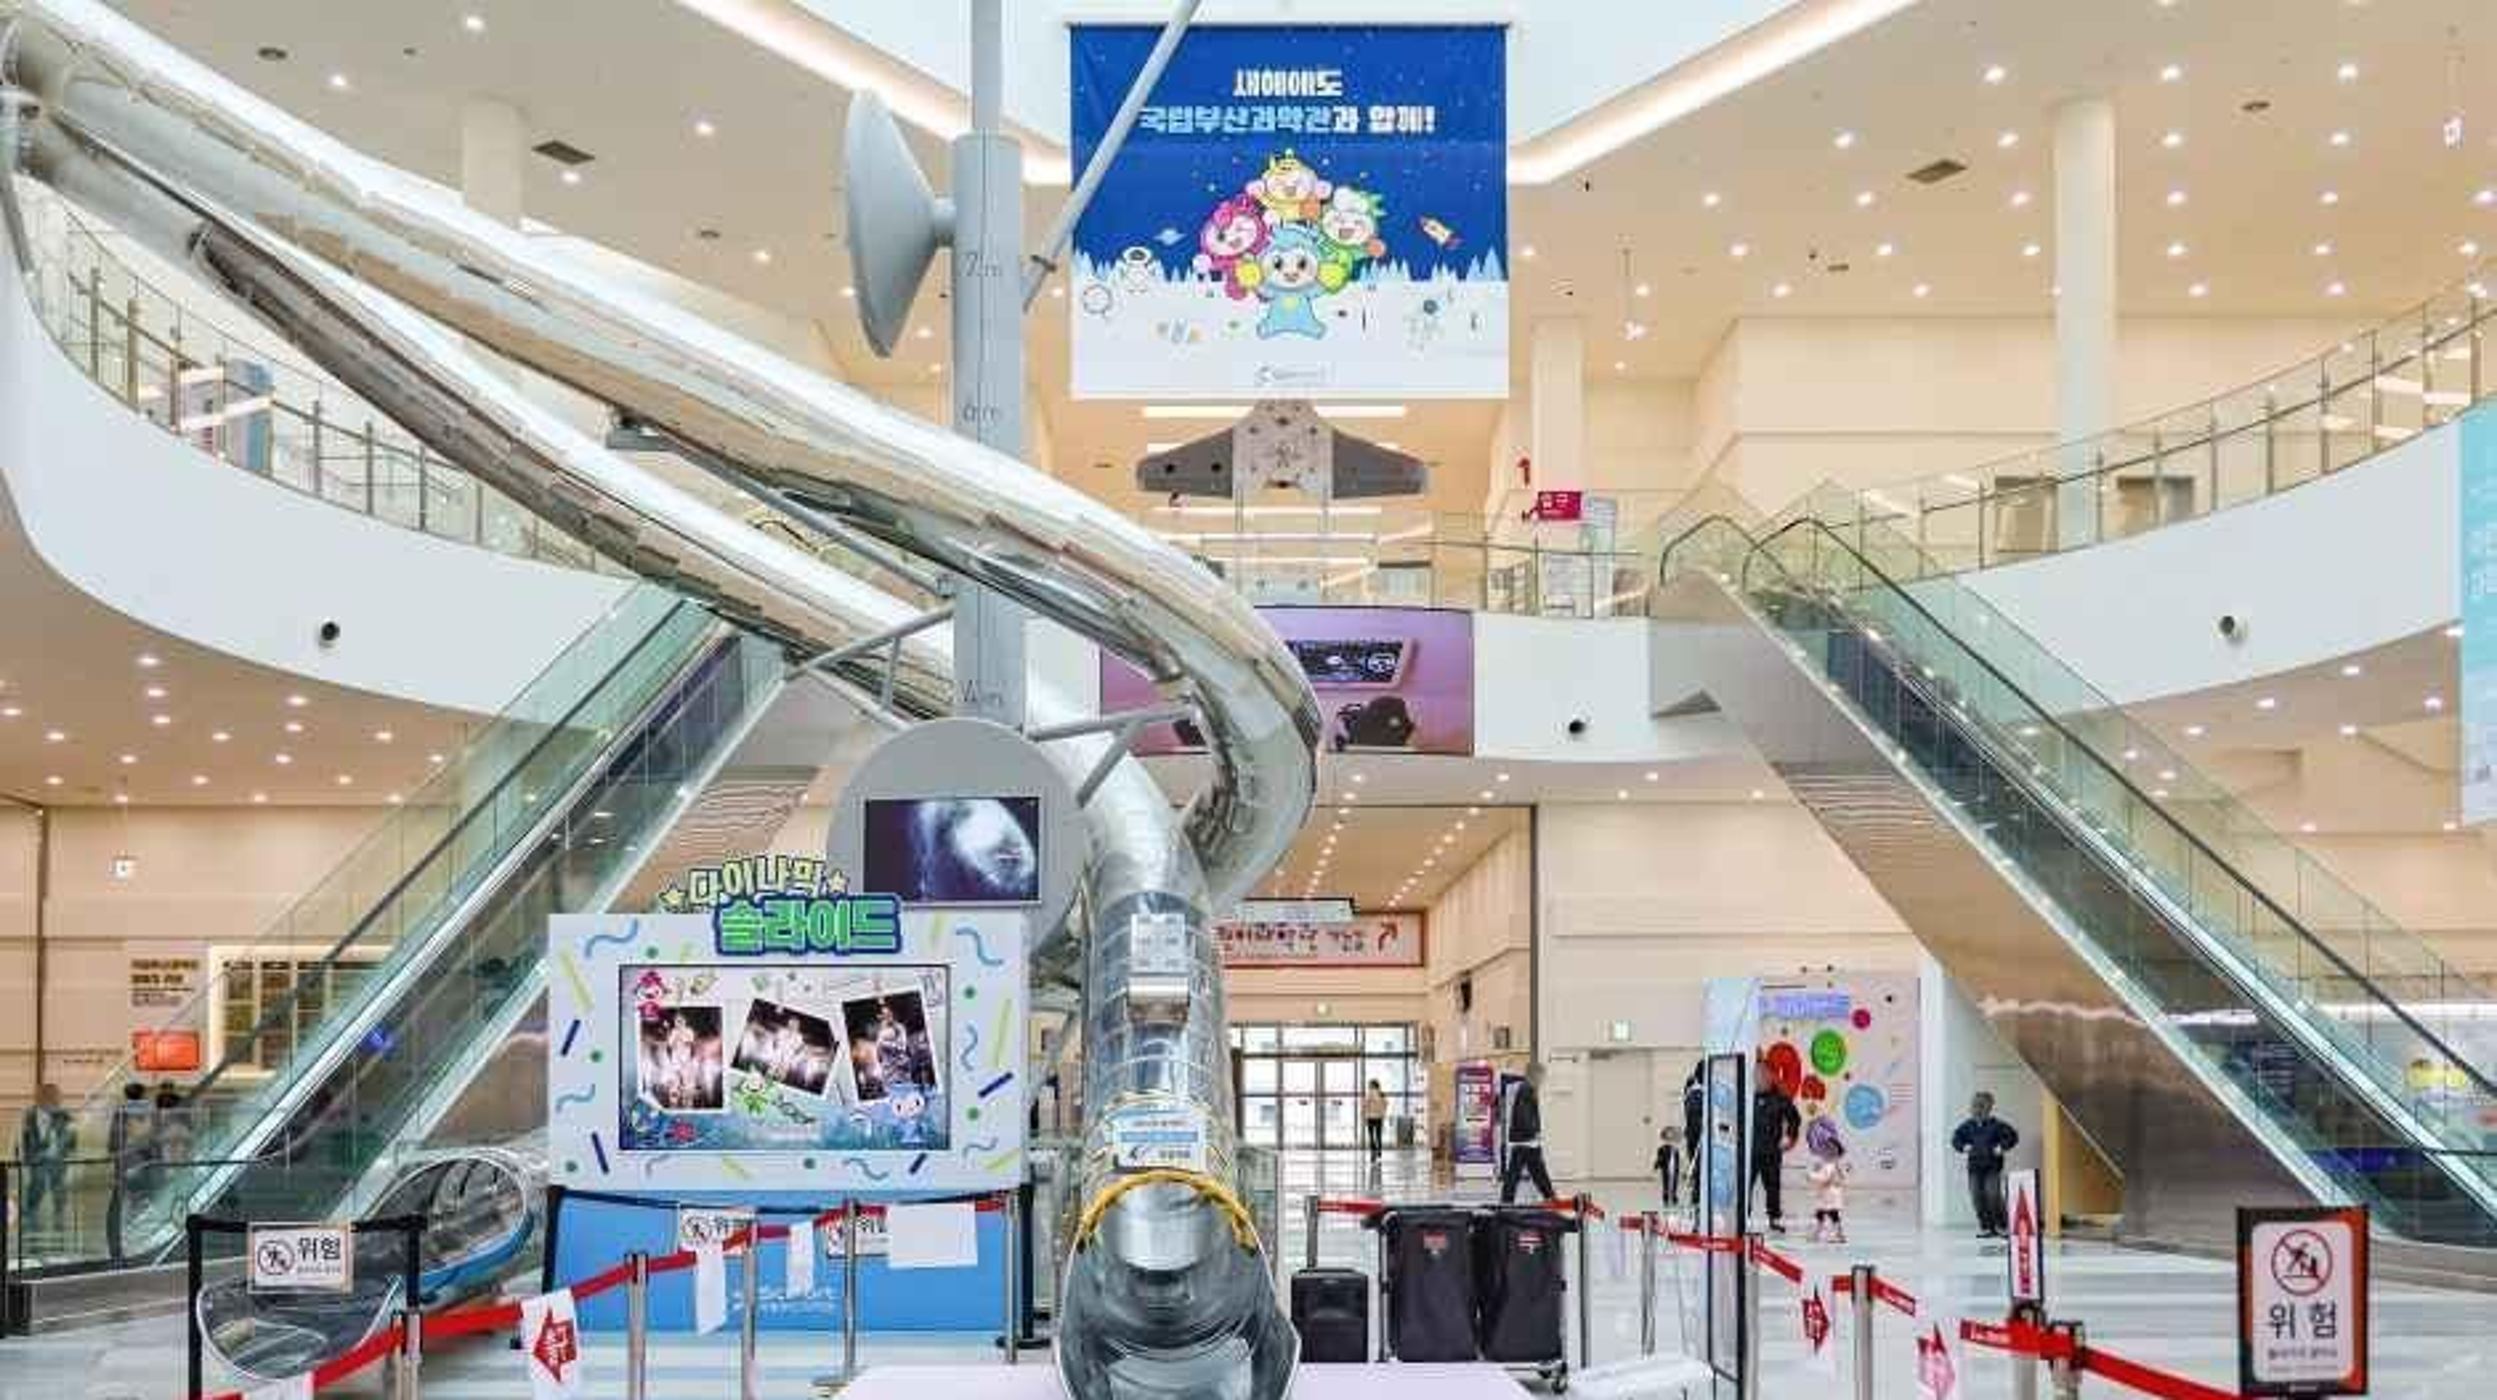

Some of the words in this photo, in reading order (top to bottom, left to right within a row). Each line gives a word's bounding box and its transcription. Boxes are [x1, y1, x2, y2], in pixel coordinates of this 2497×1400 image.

[1233, 69, 1343, 97] 새해에도
[1140, 106, 1358, 133] 국립부산과학관과
[1369, 106, 1435, 133] 함께!
[689, 854, 824, 904] 다이나믹
[720, 899, 898, 952] 슬라이드
[299, 1237, 341, 1262] 위험
[2269, 1302, 2336, 1340] 위험
